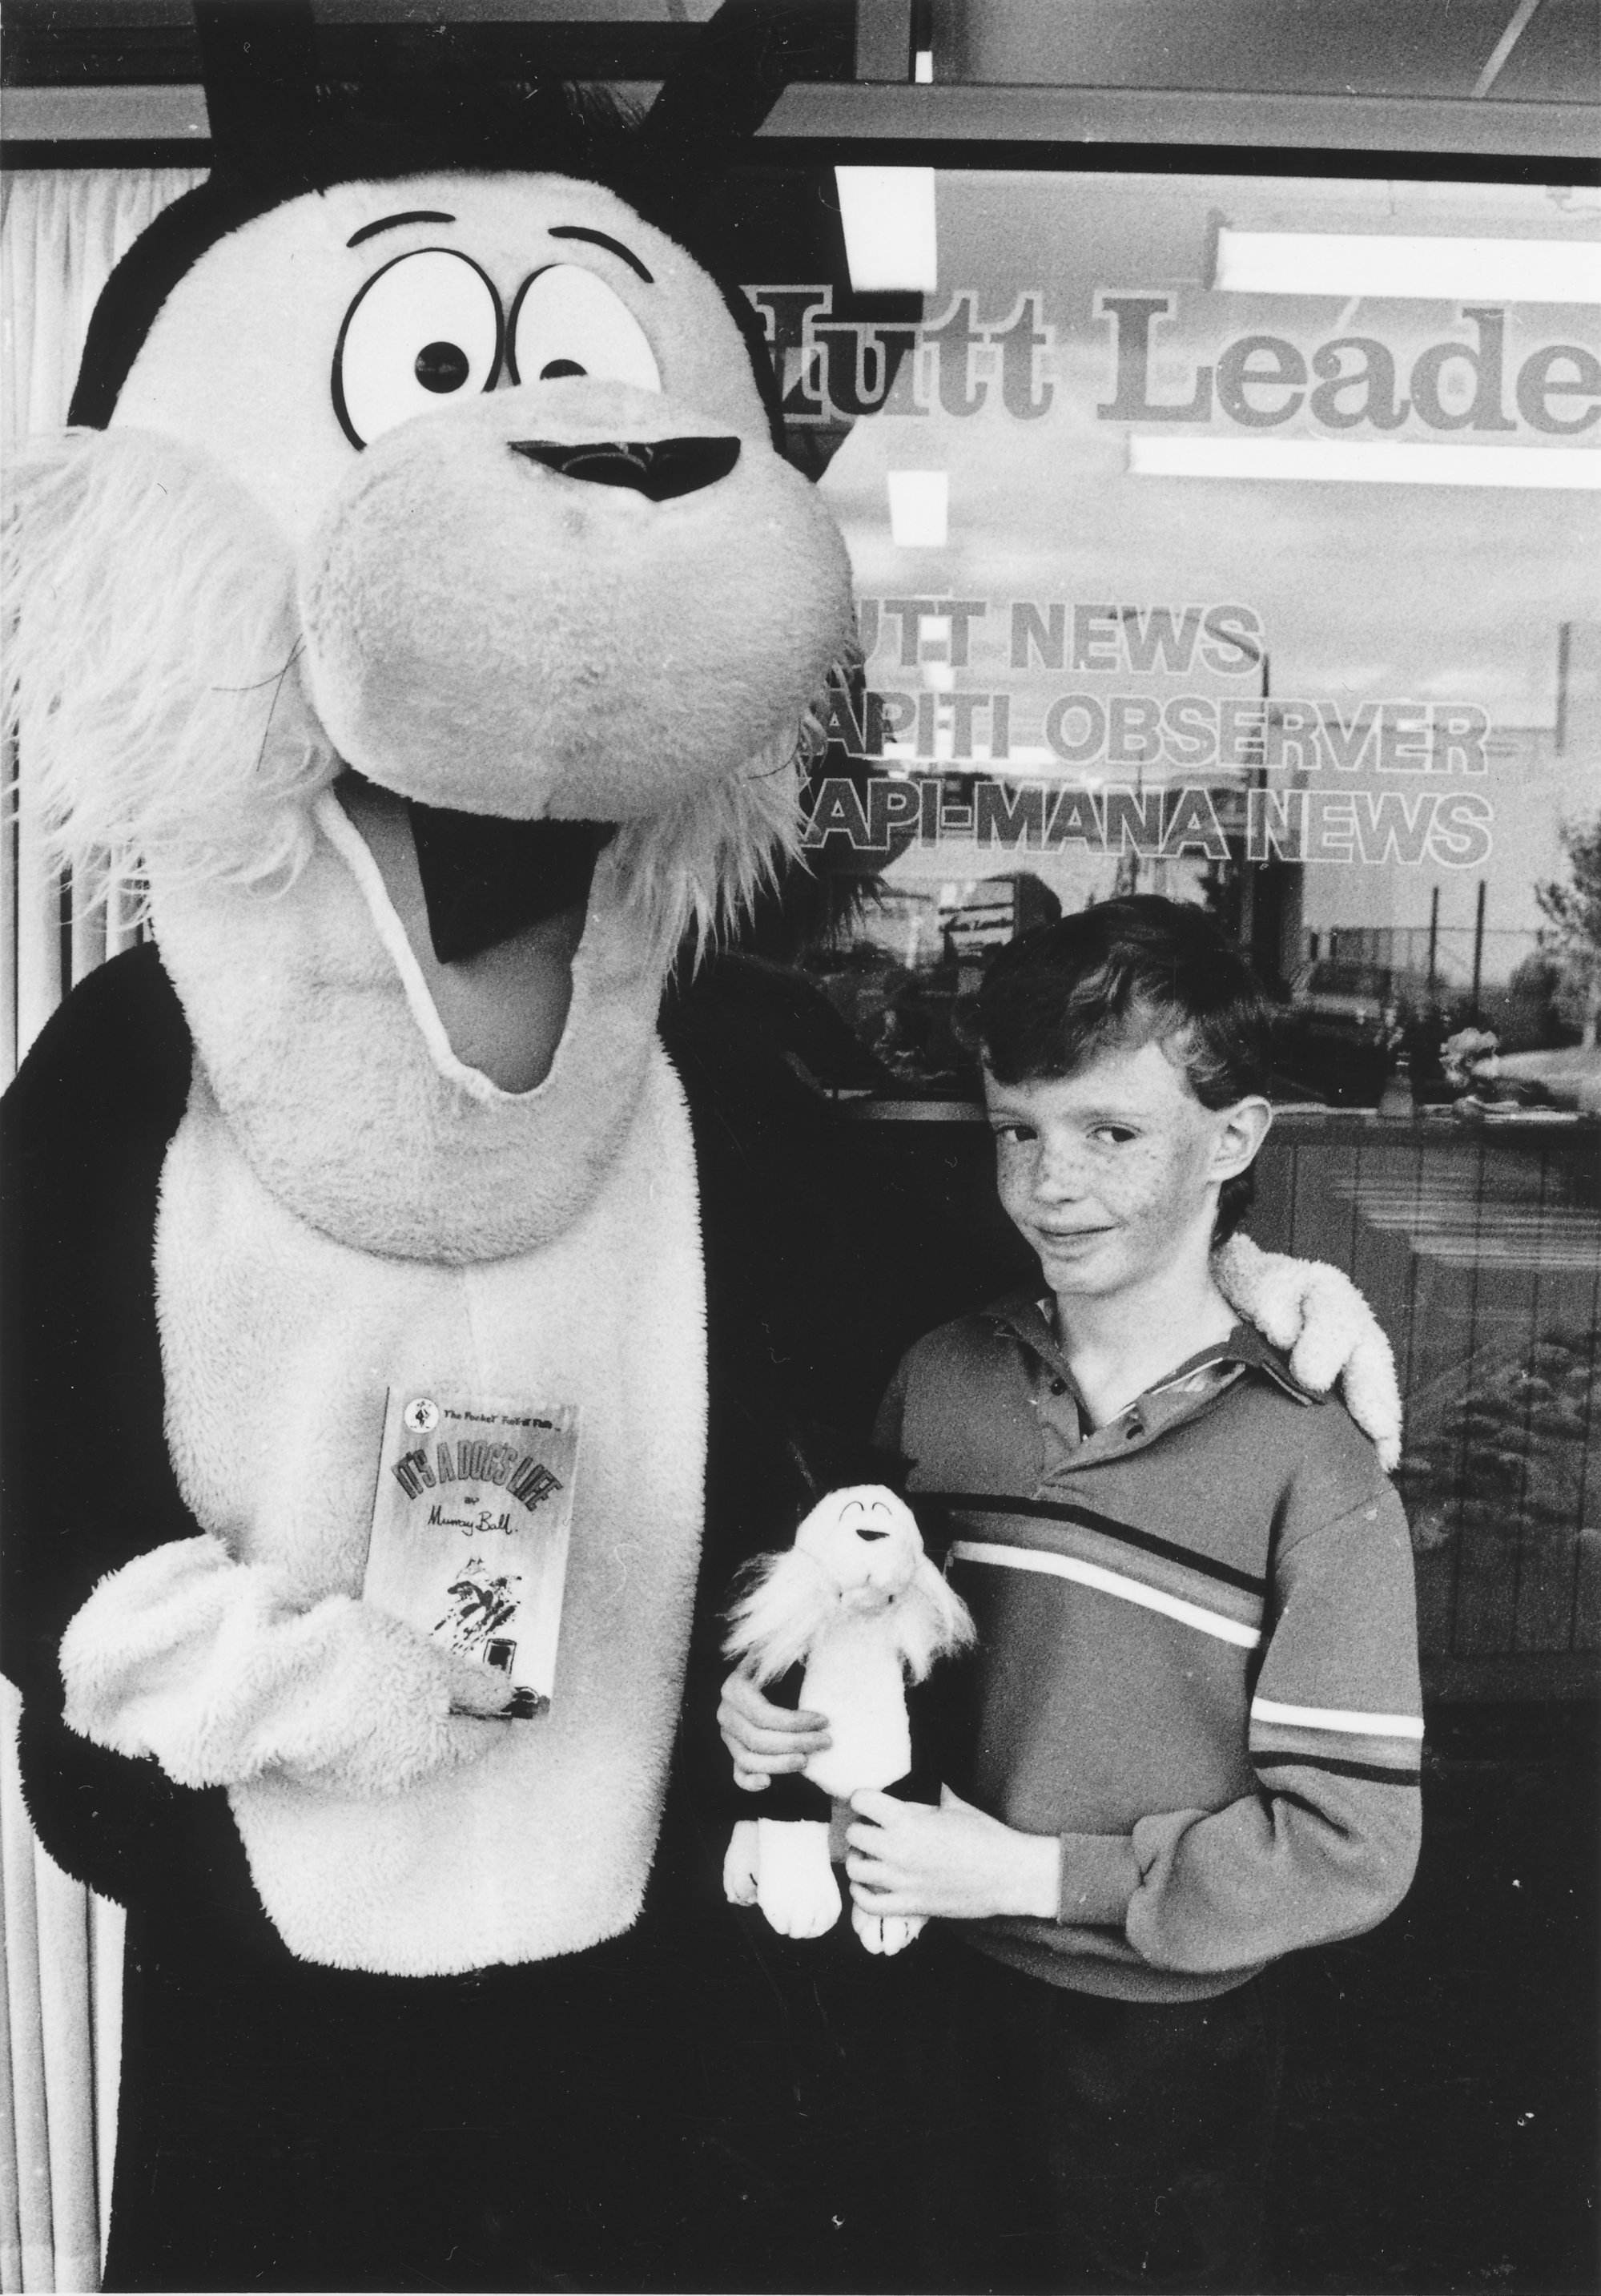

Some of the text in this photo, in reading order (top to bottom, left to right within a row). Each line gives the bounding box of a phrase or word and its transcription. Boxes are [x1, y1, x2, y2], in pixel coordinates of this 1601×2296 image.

[1094, 289, 1601, 437] Leade
[1008, 600, 1264, 677] NEWS
[1044, 693, 1490, 775] OBSERVER
[1246, 789, 1494, 868] NEWS
[444, 1410, 462, 1420] The
[465, 1412, 497, 1424] Pocket
[437, 1442, 456, 1484] A
[506, 1456, 562, 1512] LIFE
[428, 1504, 473, 1537] Murray
